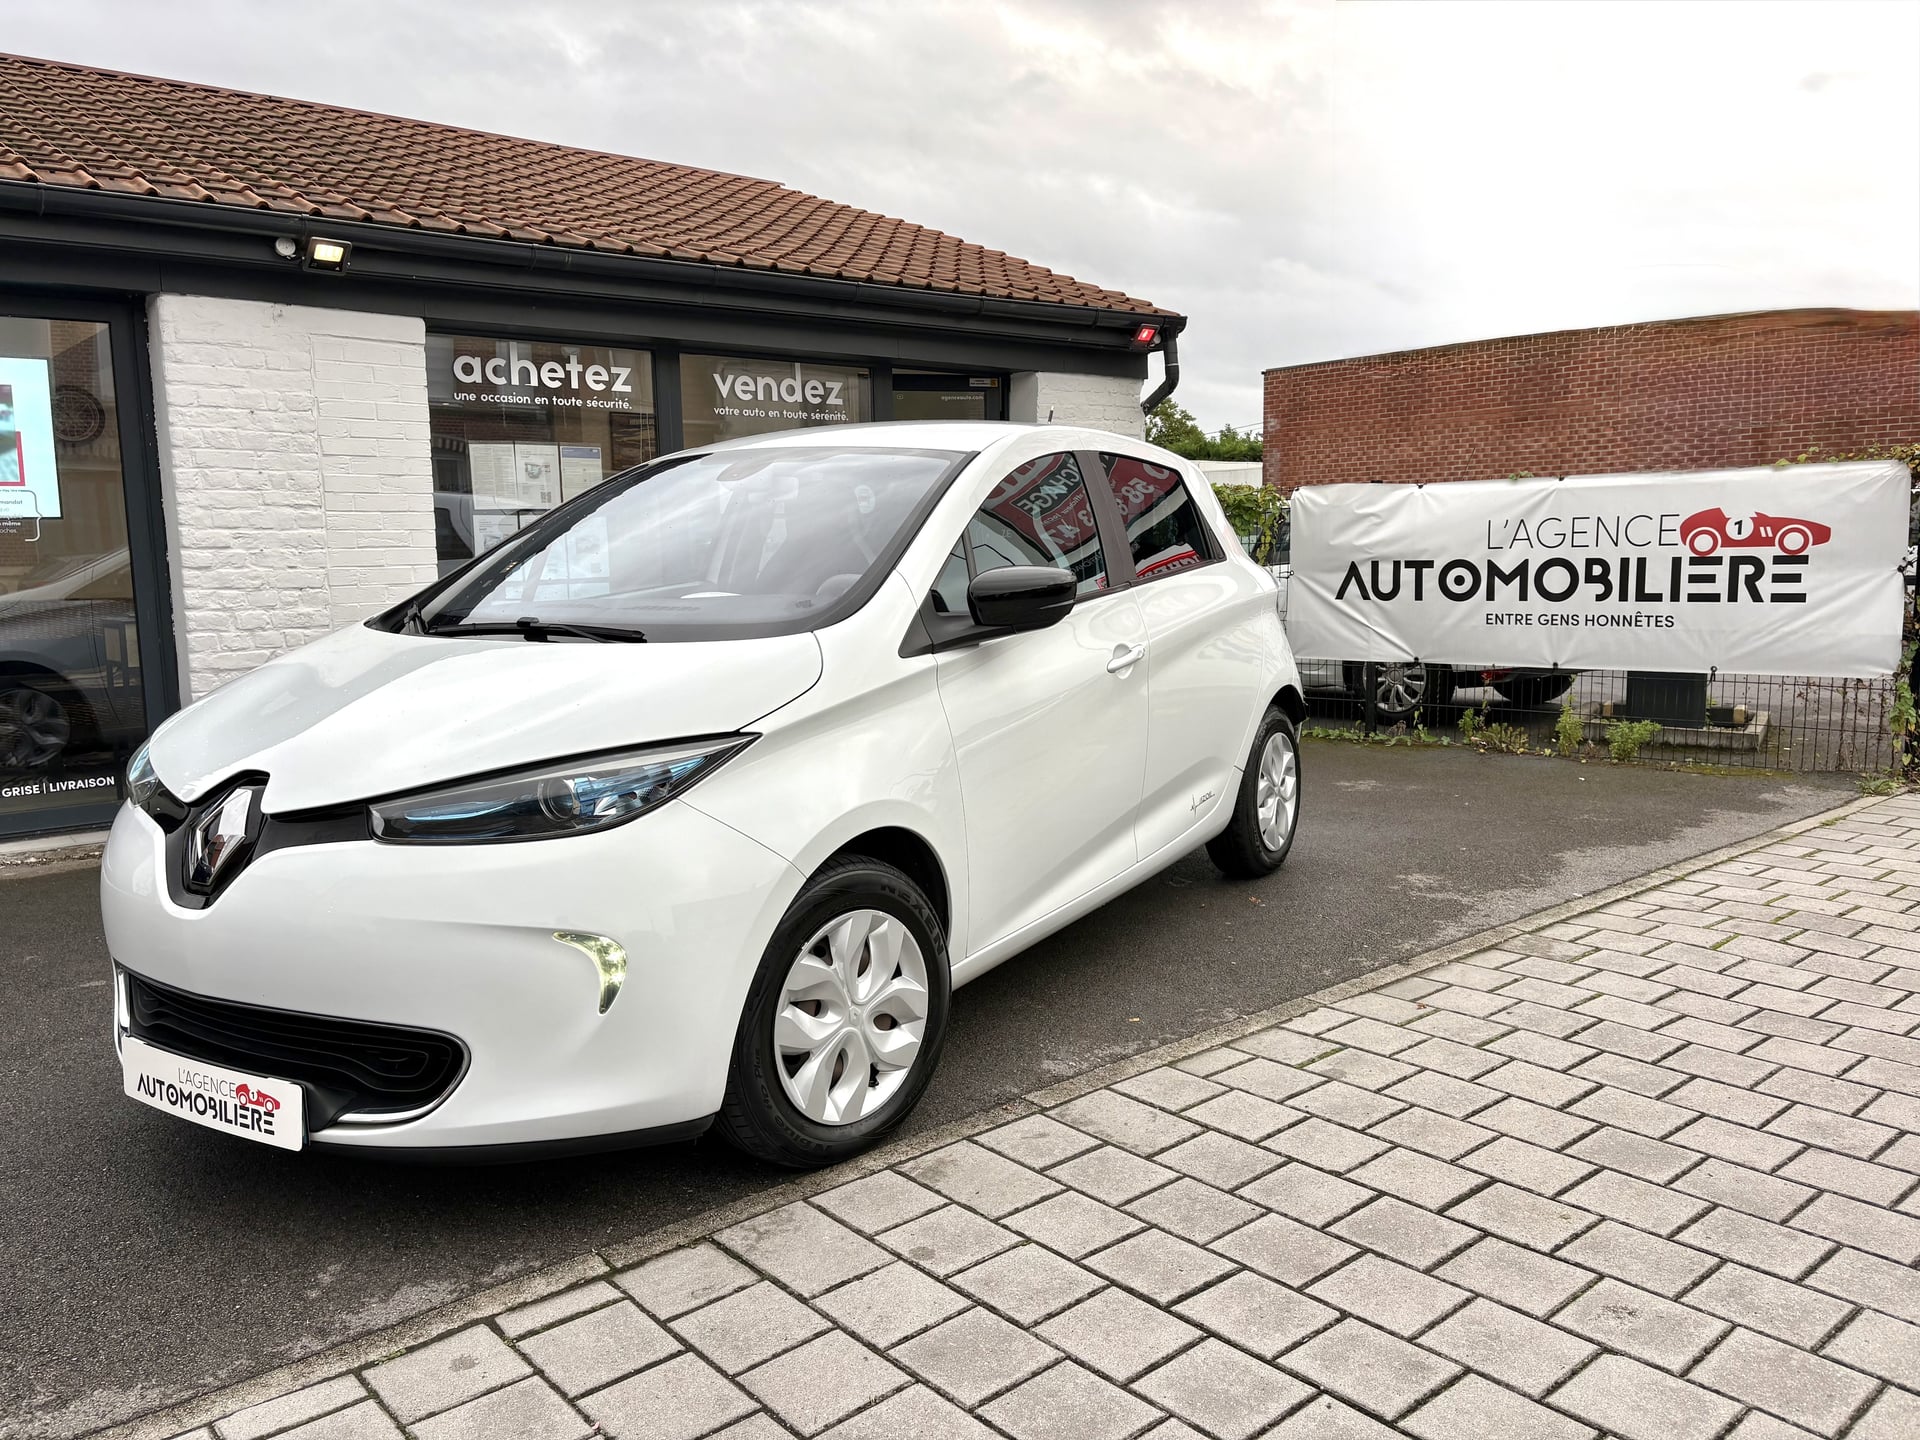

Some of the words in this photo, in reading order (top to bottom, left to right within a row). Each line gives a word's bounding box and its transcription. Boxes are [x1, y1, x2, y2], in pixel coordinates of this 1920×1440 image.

[453, 342, 632, 393] achetez
[713, 362, 843, 405] vendez
[454, 392, 477, 402] une
[480, 392, 531, 405] occasion
[535, 397, 549, 405] en
[552, 396, 583, 407] toute
[586, 396, 633, 410] sécurité.
[713, 406, 740, 416] votre
[742, 407, 766, 418] auto
[768, 410, 780, 418] en
[783, 409, 808, 420] toute
[811, 408, 849, 421] sérénité.
[1487, 513, 1680, 550] L'AGENCE
[1733, 519, 1743, 536] 1
[1486, 613, 1533, 626] ENTRE
[1538, 613, 1580, 627] GENS
[1584, 611, 1675, 628] HONNÊTES
[2, 785, 40, 797] GRISE
[49, 776, 115, 793] LIVRAISON
[178, 1067, 237, 1099] L'AGENCE
